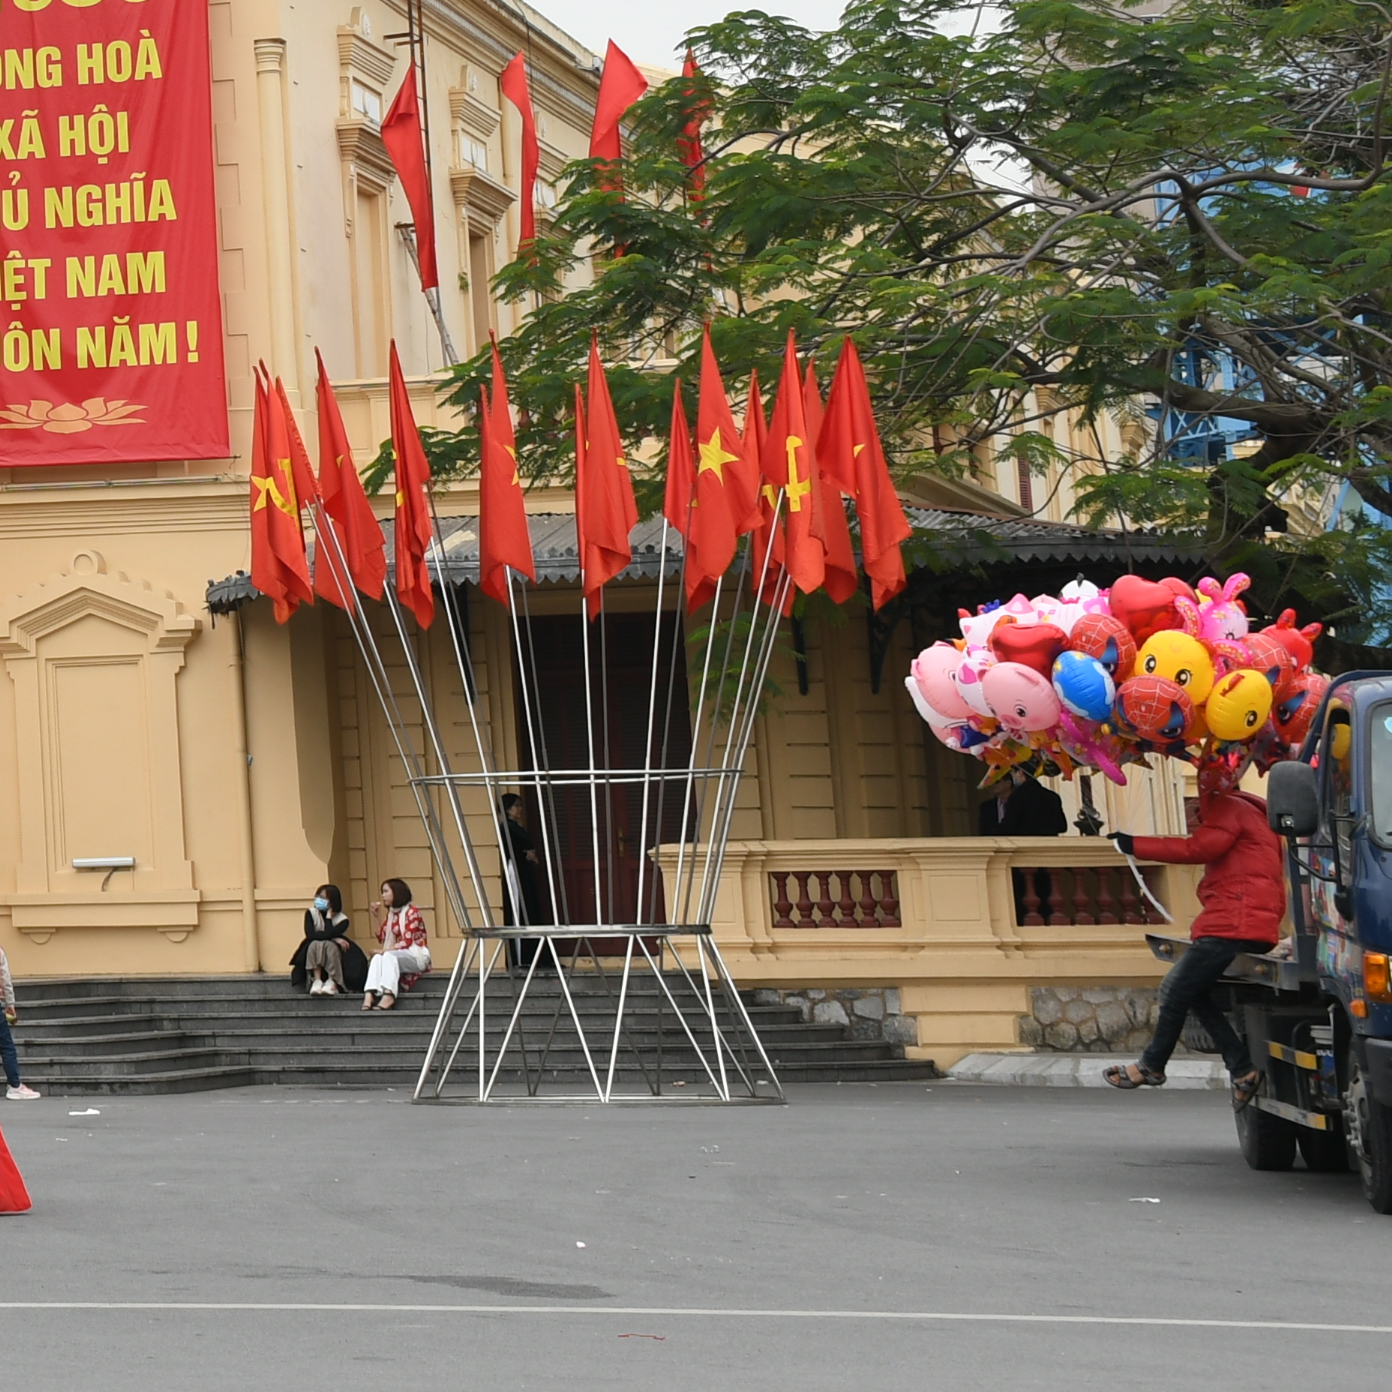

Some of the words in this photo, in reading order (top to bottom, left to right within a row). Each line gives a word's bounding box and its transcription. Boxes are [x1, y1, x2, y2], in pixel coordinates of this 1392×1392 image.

[77, 29, 163, 85] HOÀ
[59, 103, 130, 164] HỘI
[44, 171, 177, 229] NGHĨA
[66, 250, 166, 299] NAM
